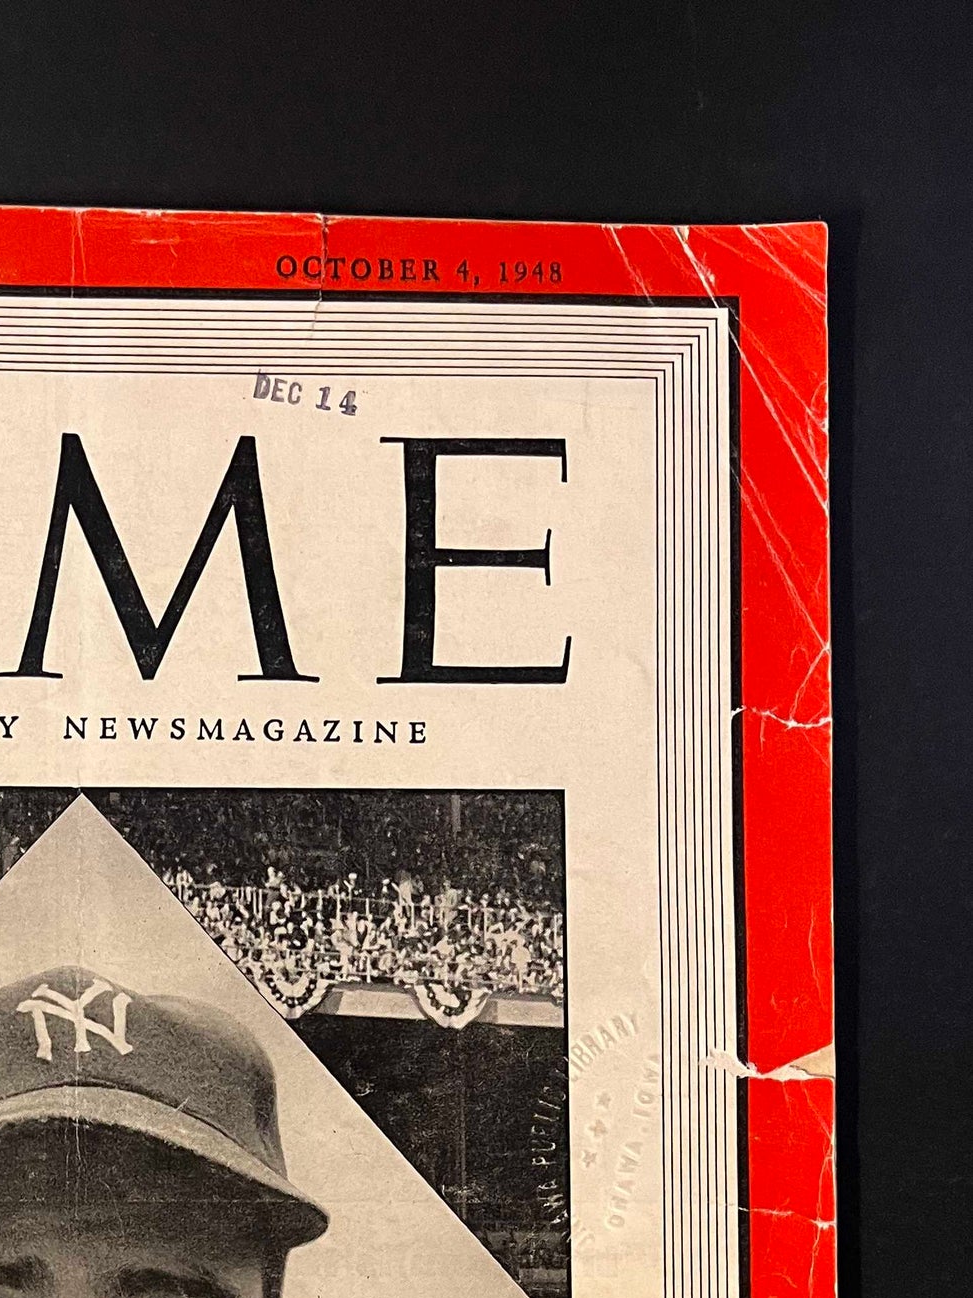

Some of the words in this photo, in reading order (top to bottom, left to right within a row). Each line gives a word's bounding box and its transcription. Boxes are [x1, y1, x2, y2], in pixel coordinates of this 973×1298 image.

[276, 254, 440, 282] OCTOBER
[456, 259, 480, 287] 4,
[499, 261, 562, 284] 1948
[253, 370, 302, 405] DEC
[315, 386, 358, 416] 14
[63, 715, 427, 744] NEWSMAGAZINE
